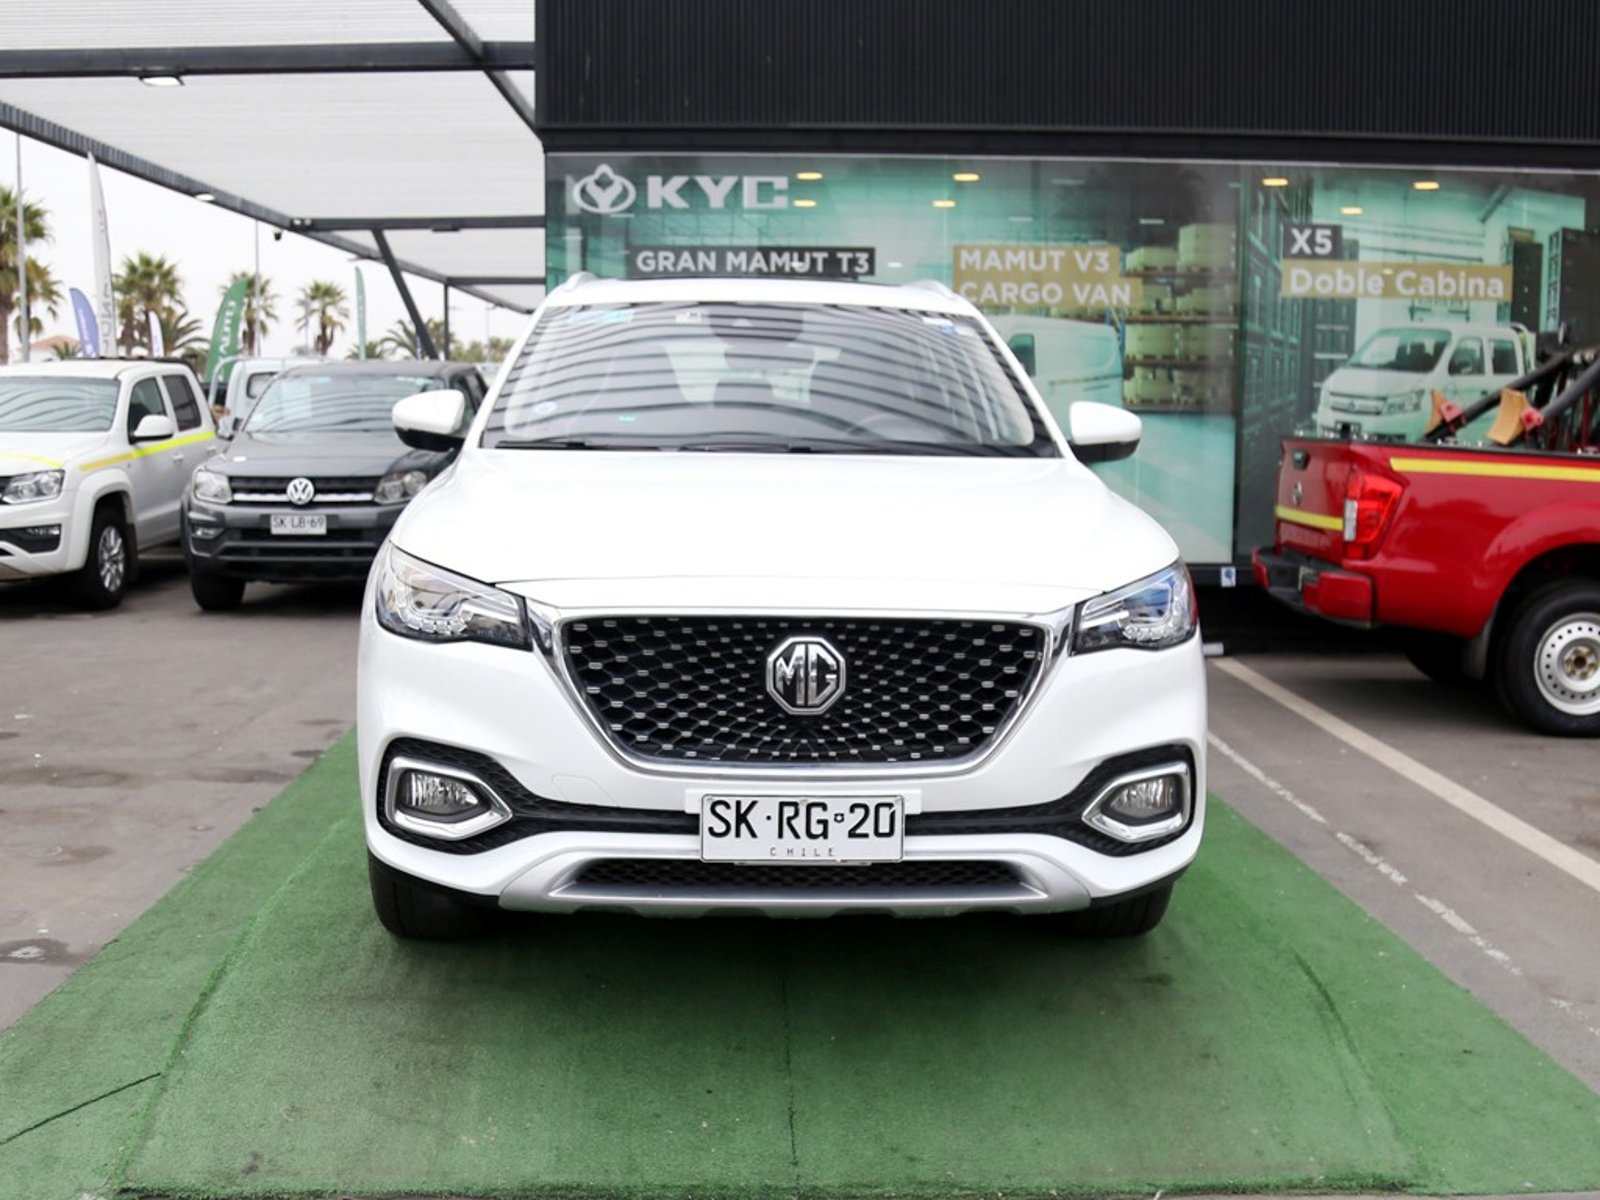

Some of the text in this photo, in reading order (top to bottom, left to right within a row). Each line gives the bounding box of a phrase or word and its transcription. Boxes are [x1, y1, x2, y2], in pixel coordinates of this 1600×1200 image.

[646, 175, 790, 210] KYC
[1290, 227, 1333, 256] X5
[635, 250, 871, 274] GRAN MAMUT T3
[959, 247, 1110, 273] MAMUT V3
[959, 281, 1132, 305] CARGO VAN
[1289, 267, 1505, 297] Doble Cabina
[775, 643, 838, 707] MG
[769, 847, 835, 858] CHILE
